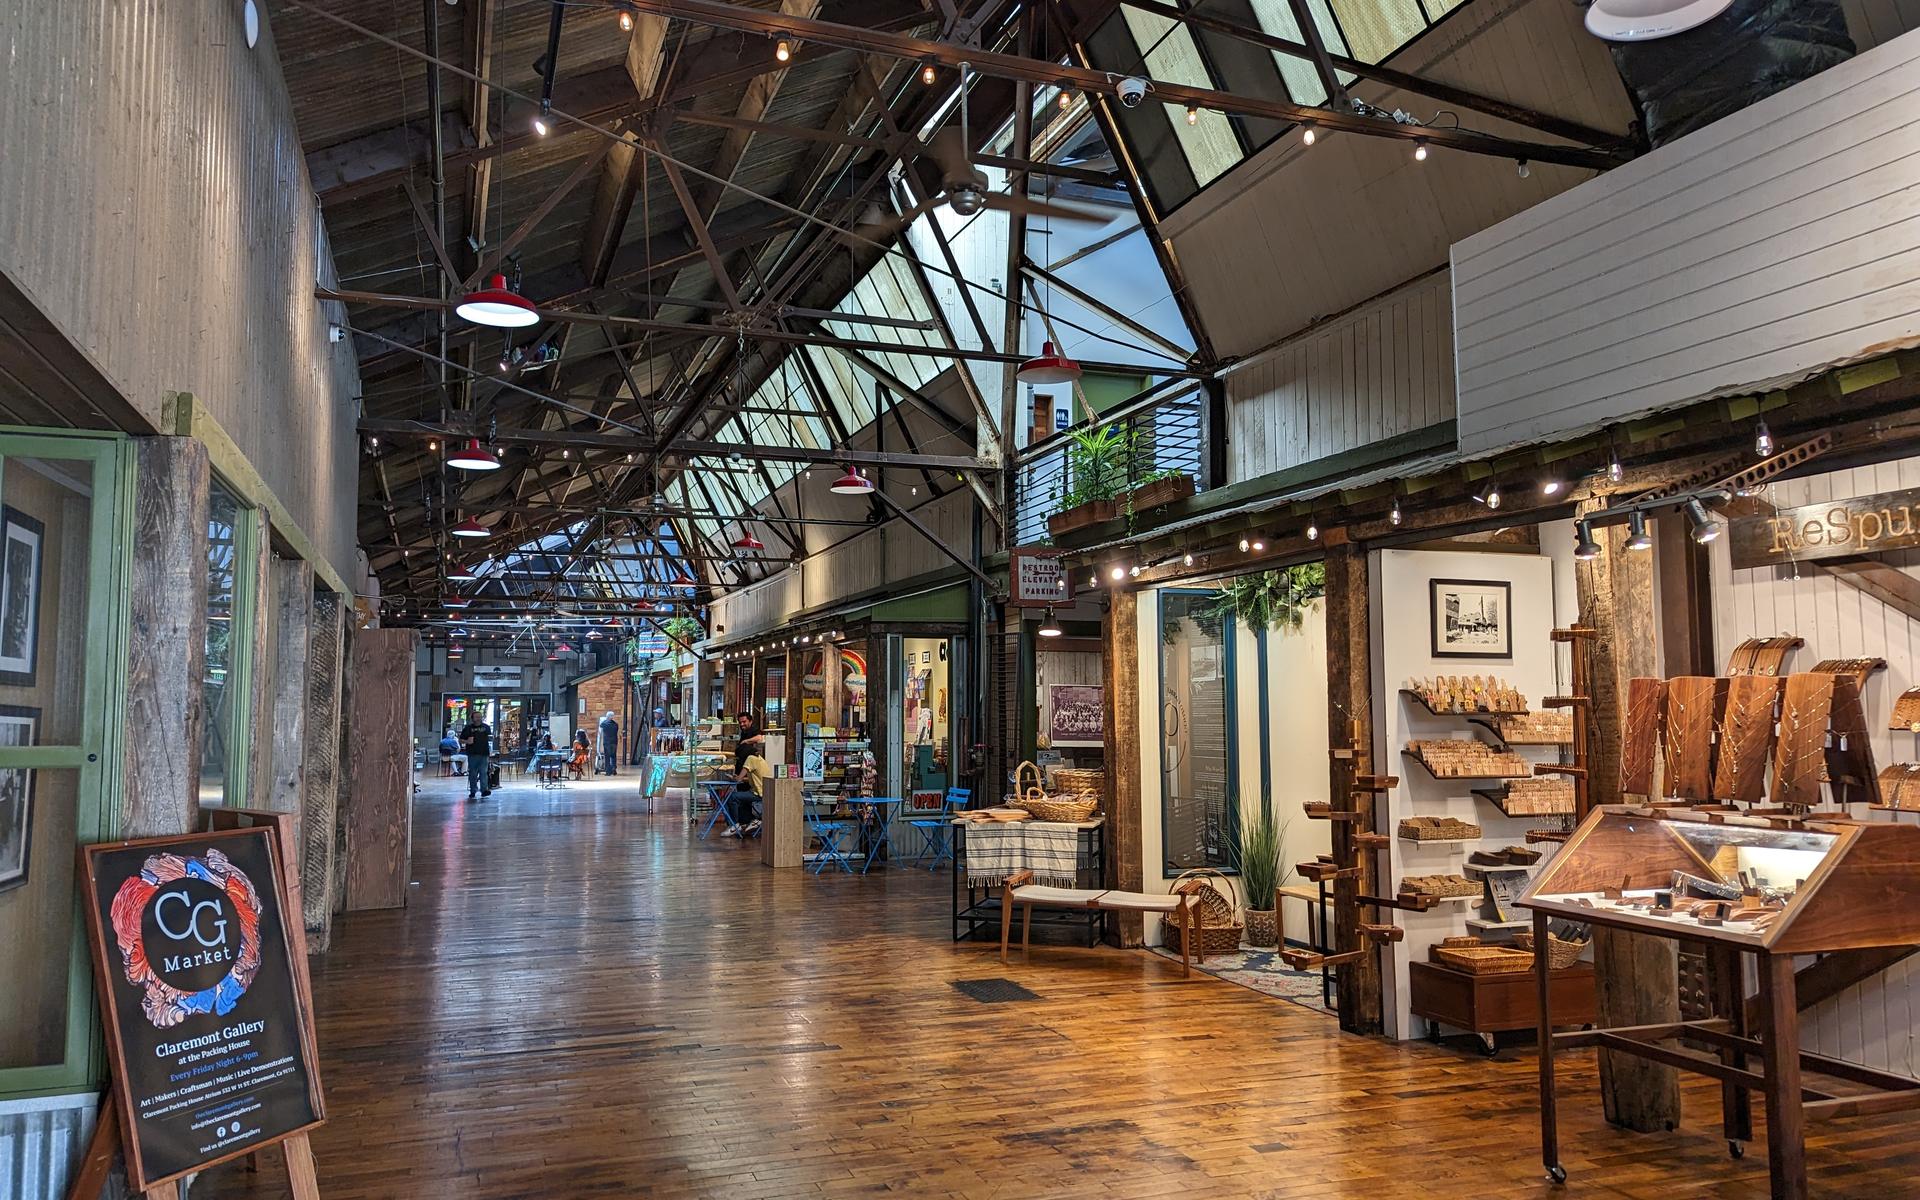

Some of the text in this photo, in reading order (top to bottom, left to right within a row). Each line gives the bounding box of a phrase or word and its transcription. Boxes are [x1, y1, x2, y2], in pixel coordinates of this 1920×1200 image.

[1767, 506, 1920, 553] ReSpu
[914, 793, 942, 810] OPEN
[155, 890, 228, 947] CG
[163, 946, 232, 973] Market
[155, 1020, 265, 1057] Claremont Gallery
[178, 1039, 251, 1065] at the Packing House
[140, 1055, 294, 1107] Art Makers Craftsman Music Live Demonstrations
[170, 1051, 259, 1082] Every Friday Night 6-9pm
[142, 1106, 170, 1119] Claremont
[169, 1100, 188, 1111] Packing
[188, 1095, 205, 1105] House
[204, 1090, 222, 1100] Atrium
[200, 1144, 211, 1154] Find
[217, 1127, 261, 1148] @claremontgallery
